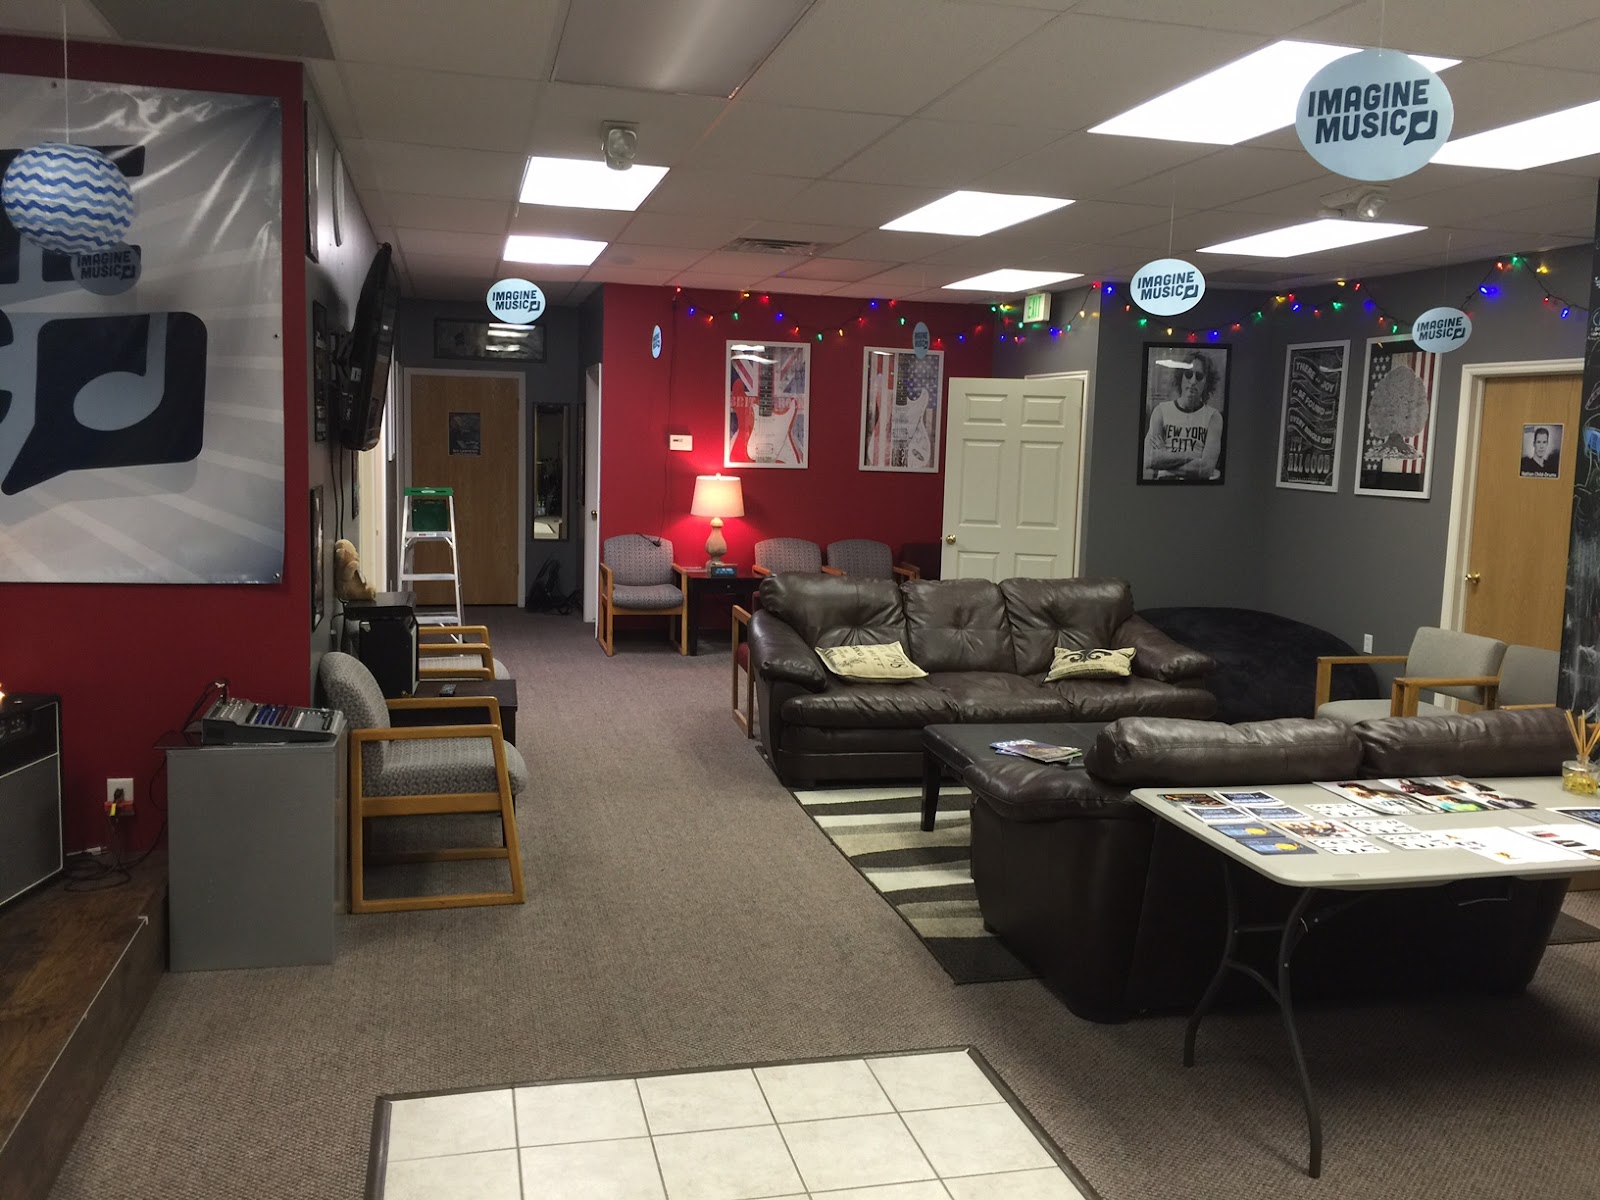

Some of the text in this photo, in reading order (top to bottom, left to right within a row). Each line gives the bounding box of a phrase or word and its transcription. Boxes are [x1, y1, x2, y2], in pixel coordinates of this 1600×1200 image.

[1308, 79, 1430, 117] IMAGINE
[1315, 109, 1407, 144] MUSIC
[77, 250, 131, 267] IMAGINE
[81, 264, 121, 279] MUSIC
[1137, 271, 1195, 289] IMAGINE
[492, 290, 537, 301] IMAGINE
[1140, 284, 1184, 300] MUSIC
[495, 300, 529, 310] MUSIC
[1417, 317, 1463, 332] IMAGINE
[1419, 328, 1453, 341] MUSIC
[1295, 362, 1316, 380] THERE
[1321, 380, 1335, 393] JOY
[1171, 438, 1197, 453] CITY
